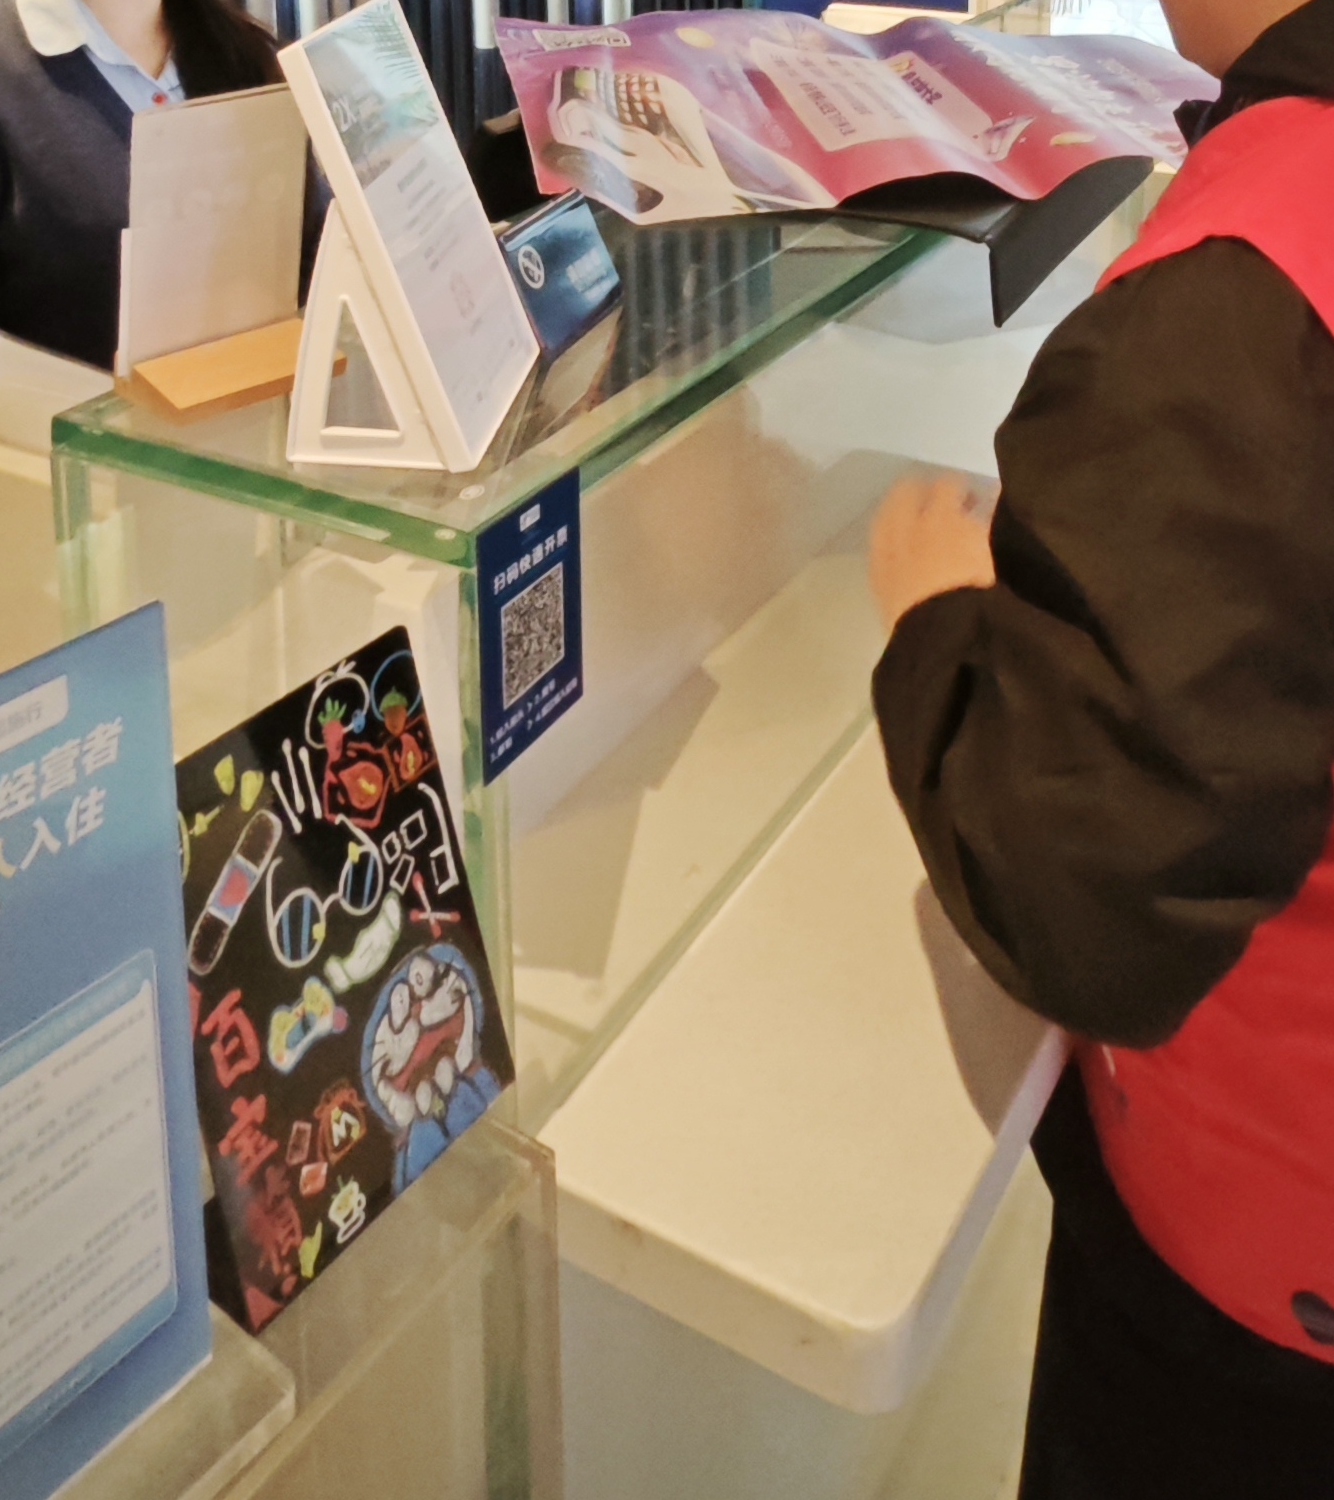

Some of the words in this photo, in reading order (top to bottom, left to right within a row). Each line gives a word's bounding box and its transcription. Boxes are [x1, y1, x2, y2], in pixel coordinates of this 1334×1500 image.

[493, 524, 568, 596] 扫码快速开票
